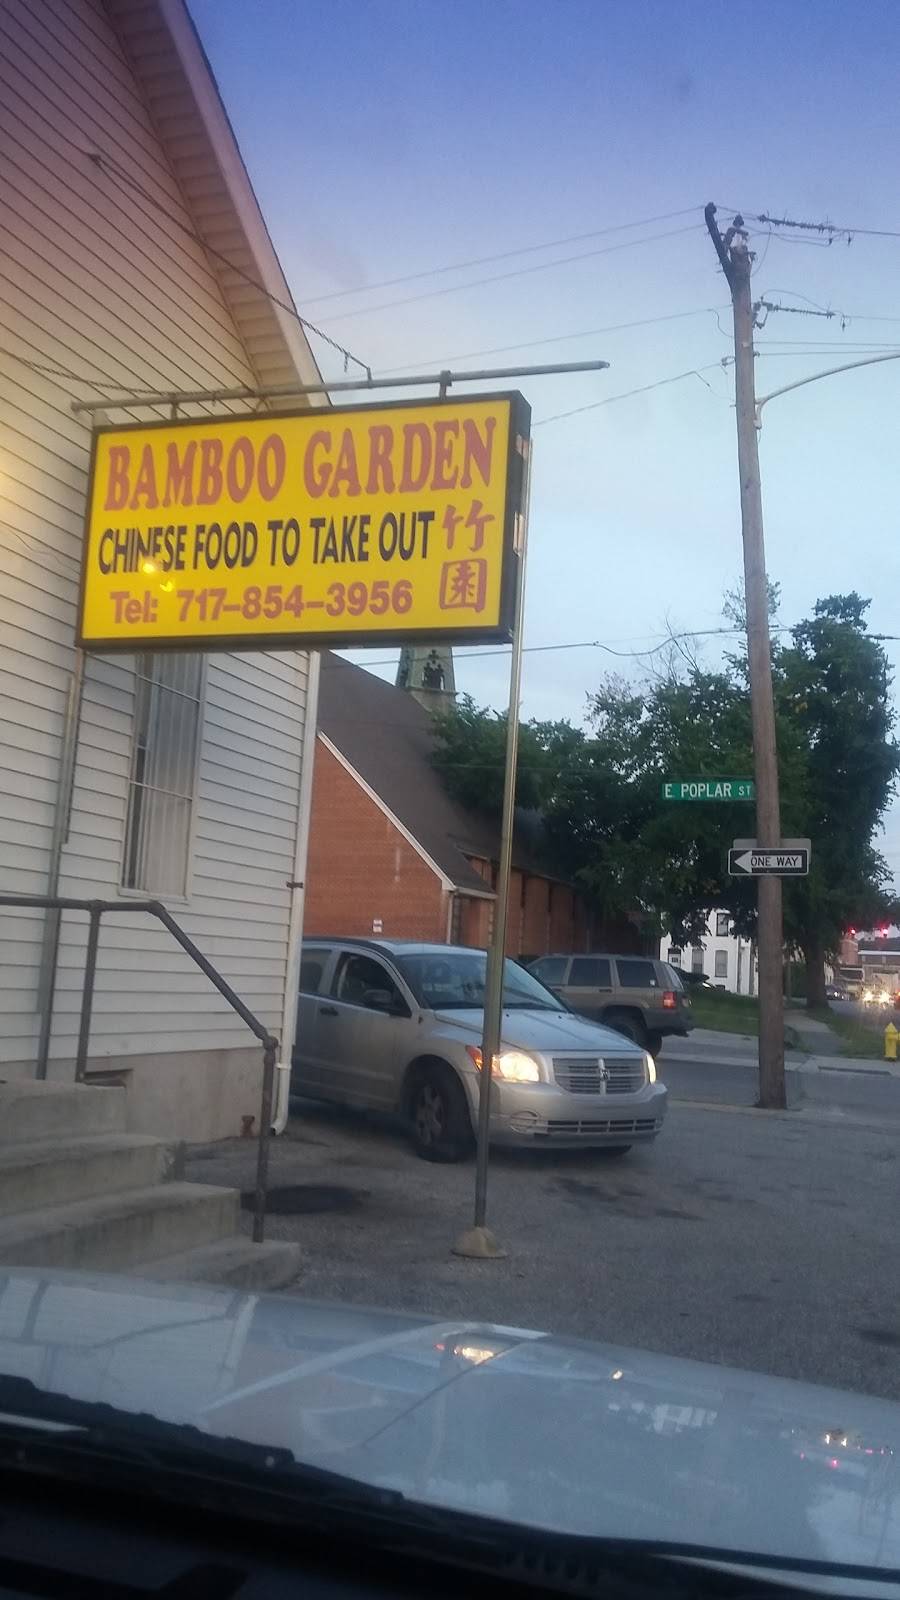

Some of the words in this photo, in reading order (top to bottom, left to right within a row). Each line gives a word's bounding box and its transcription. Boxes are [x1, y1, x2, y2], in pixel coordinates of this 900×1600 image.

[103, 433, 287, 512] BAMBOO
[303, 416, 497, 499] GARDEN
[99, 525, 188, 575] CHINESE
[193, 521, 259, 570] FOOD
[267, 518, 301, 566] TO
[309, 514, 372, 564] TAKE
[378, 510, 436, 562] OUT
[110, 591, 159, 624] Tel:
[177, 579, 414, 622] 717-854-3956
[664, 783, 674, 798] E
[681, 782, 732, 798] POPLAR
[738, 785, 751, 796] ST
[750, 857, 771, 866] ONE
[777, 856, 799, 867] WAY
